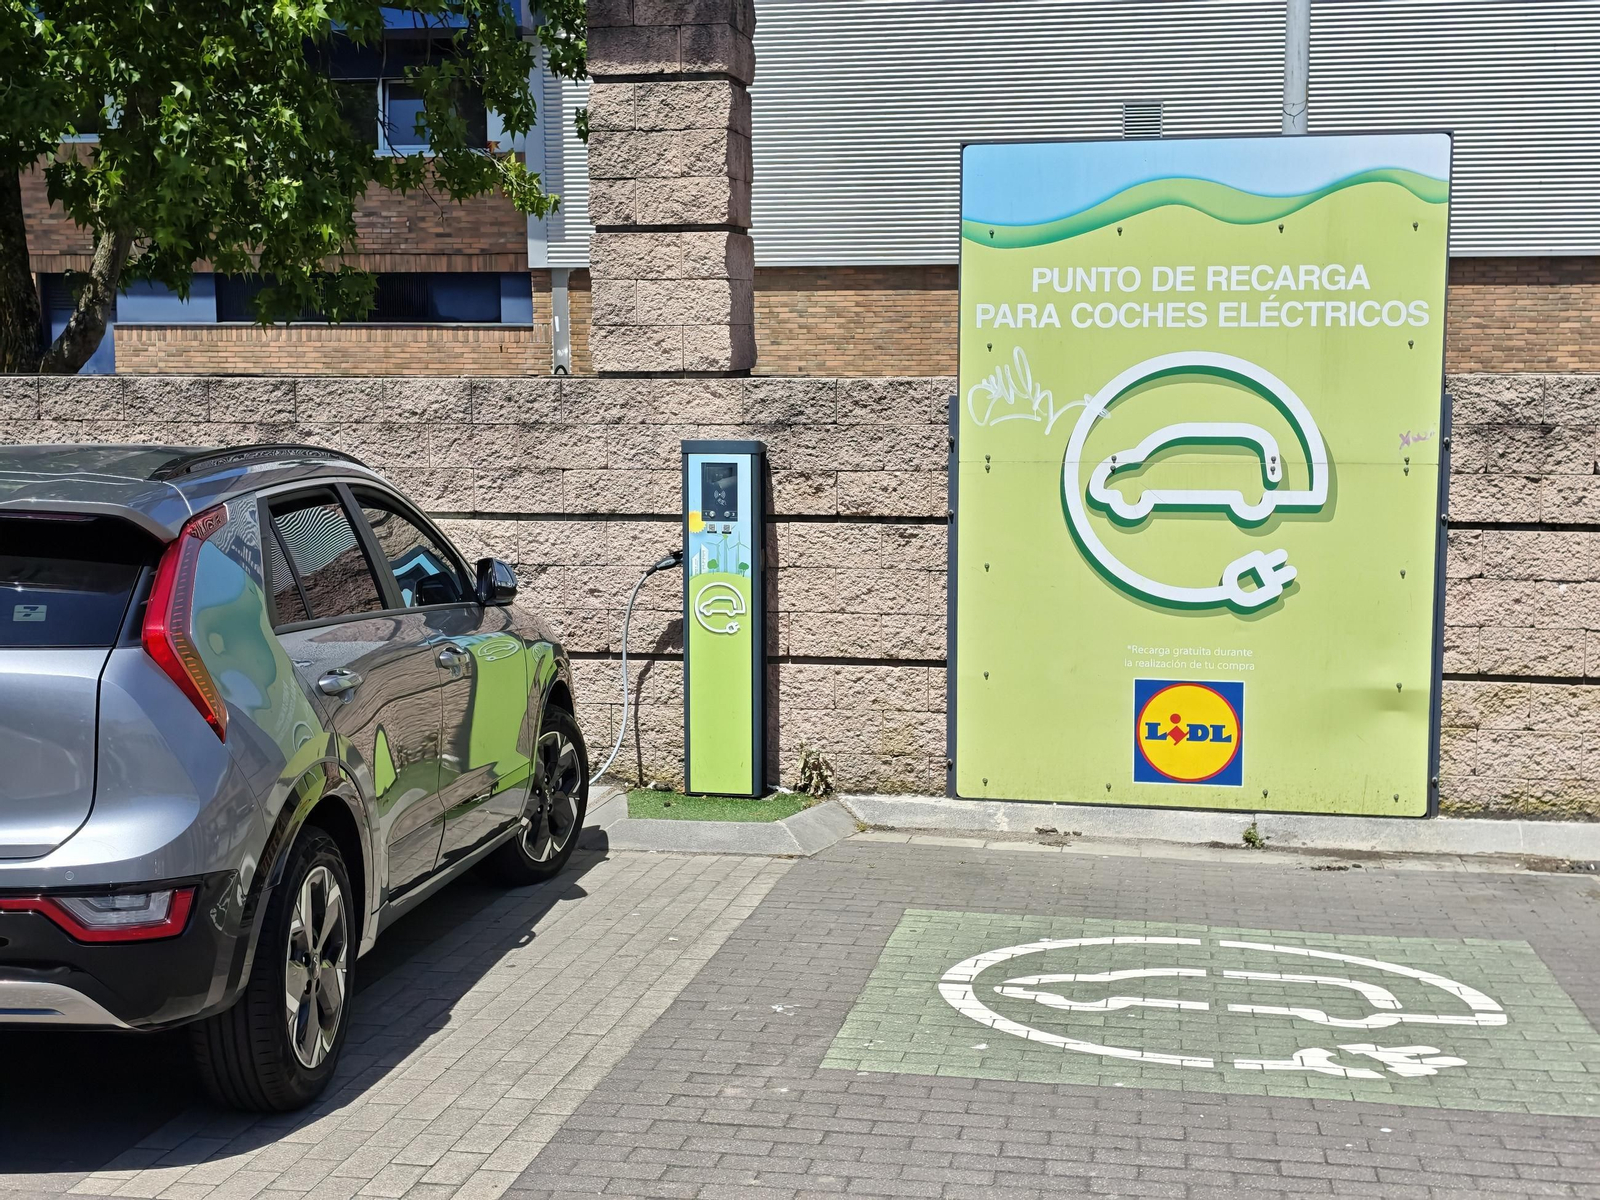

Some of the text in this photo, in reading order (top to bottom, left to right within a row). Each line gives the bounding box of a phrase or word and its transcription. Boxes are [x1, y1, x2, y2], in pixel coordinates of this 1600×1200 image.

[1032, 264, 1371, 293] PUNTO DE RECARGA
[975, 294, 1430, 329] PARA COCHES ELÉCTRICOS
[1173, 646, 1212, 658] gratuita
[1213, 647, 1254, 658] durante
[1124, 658, 1255, 672] la realización de tu compra
